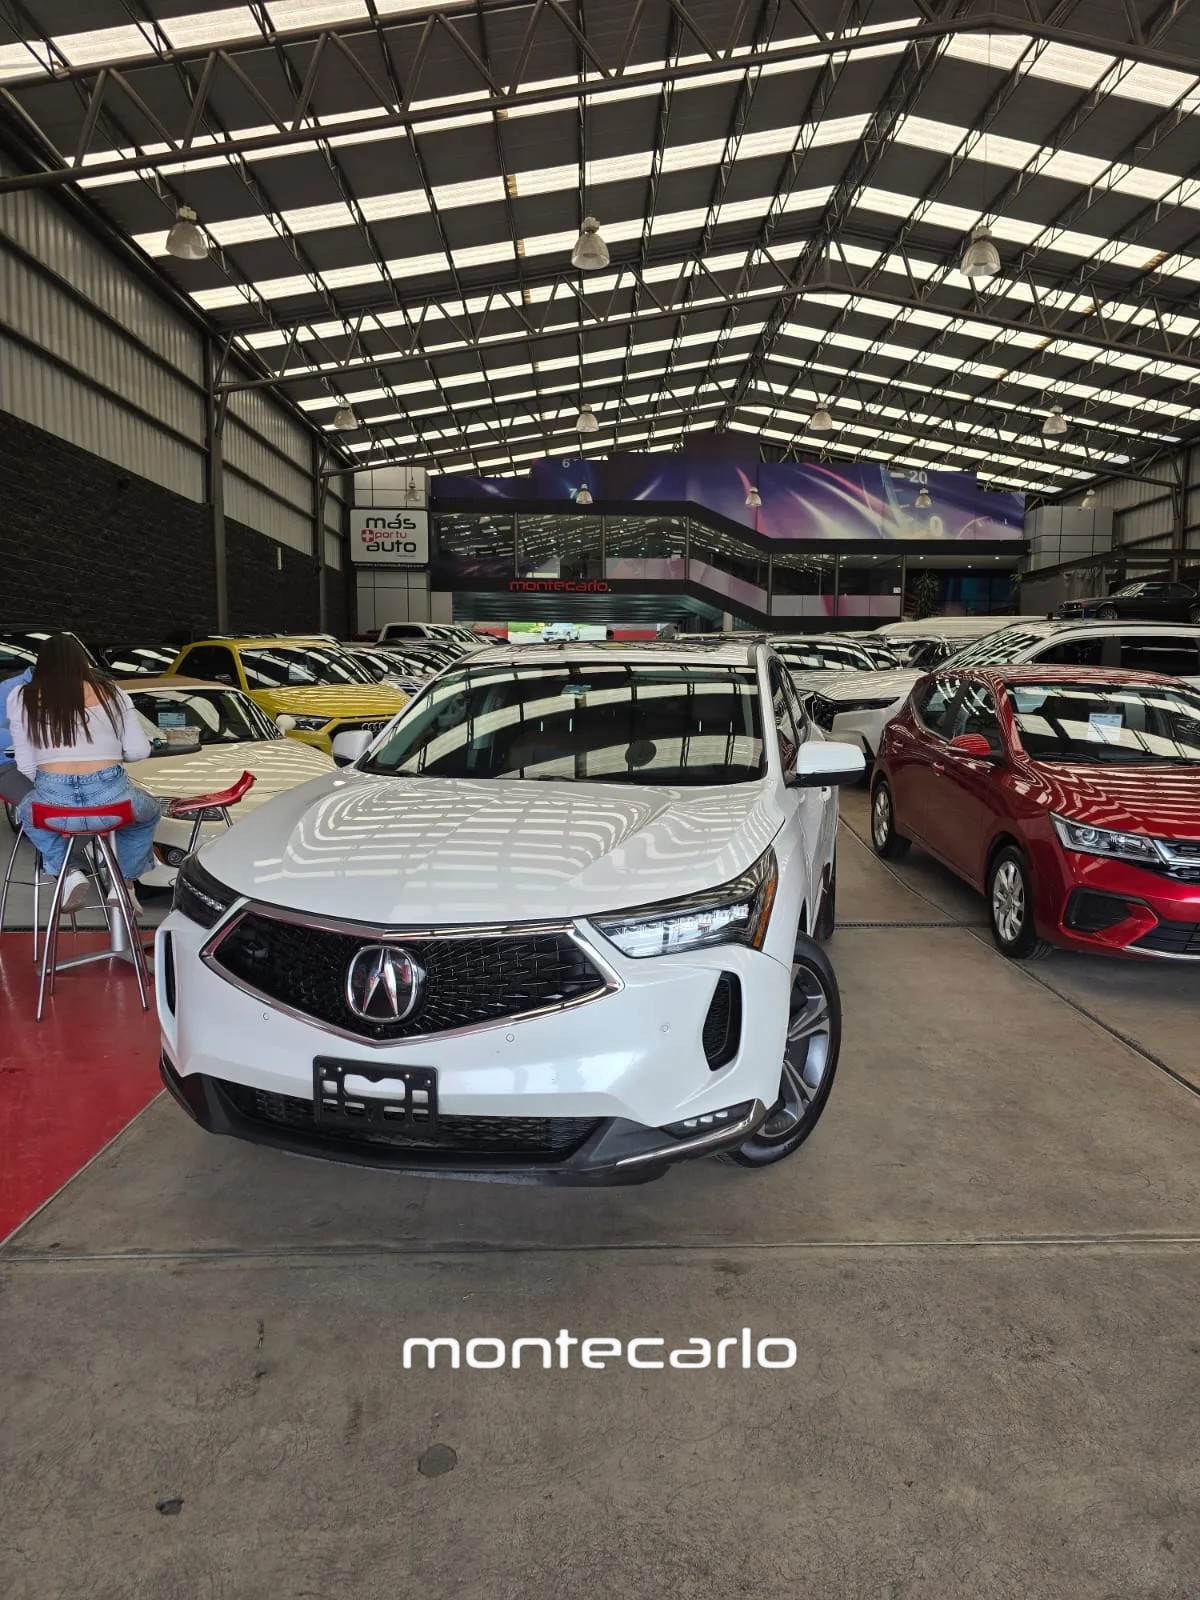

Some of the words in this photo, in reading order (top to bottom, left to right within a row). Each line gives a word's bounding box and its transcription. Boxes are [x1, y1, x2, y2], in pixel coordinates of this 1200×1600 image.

[909, 470, 928, 484] 20
[366, 512, 417, 530] más
[366, 540, 417, 553] auto
